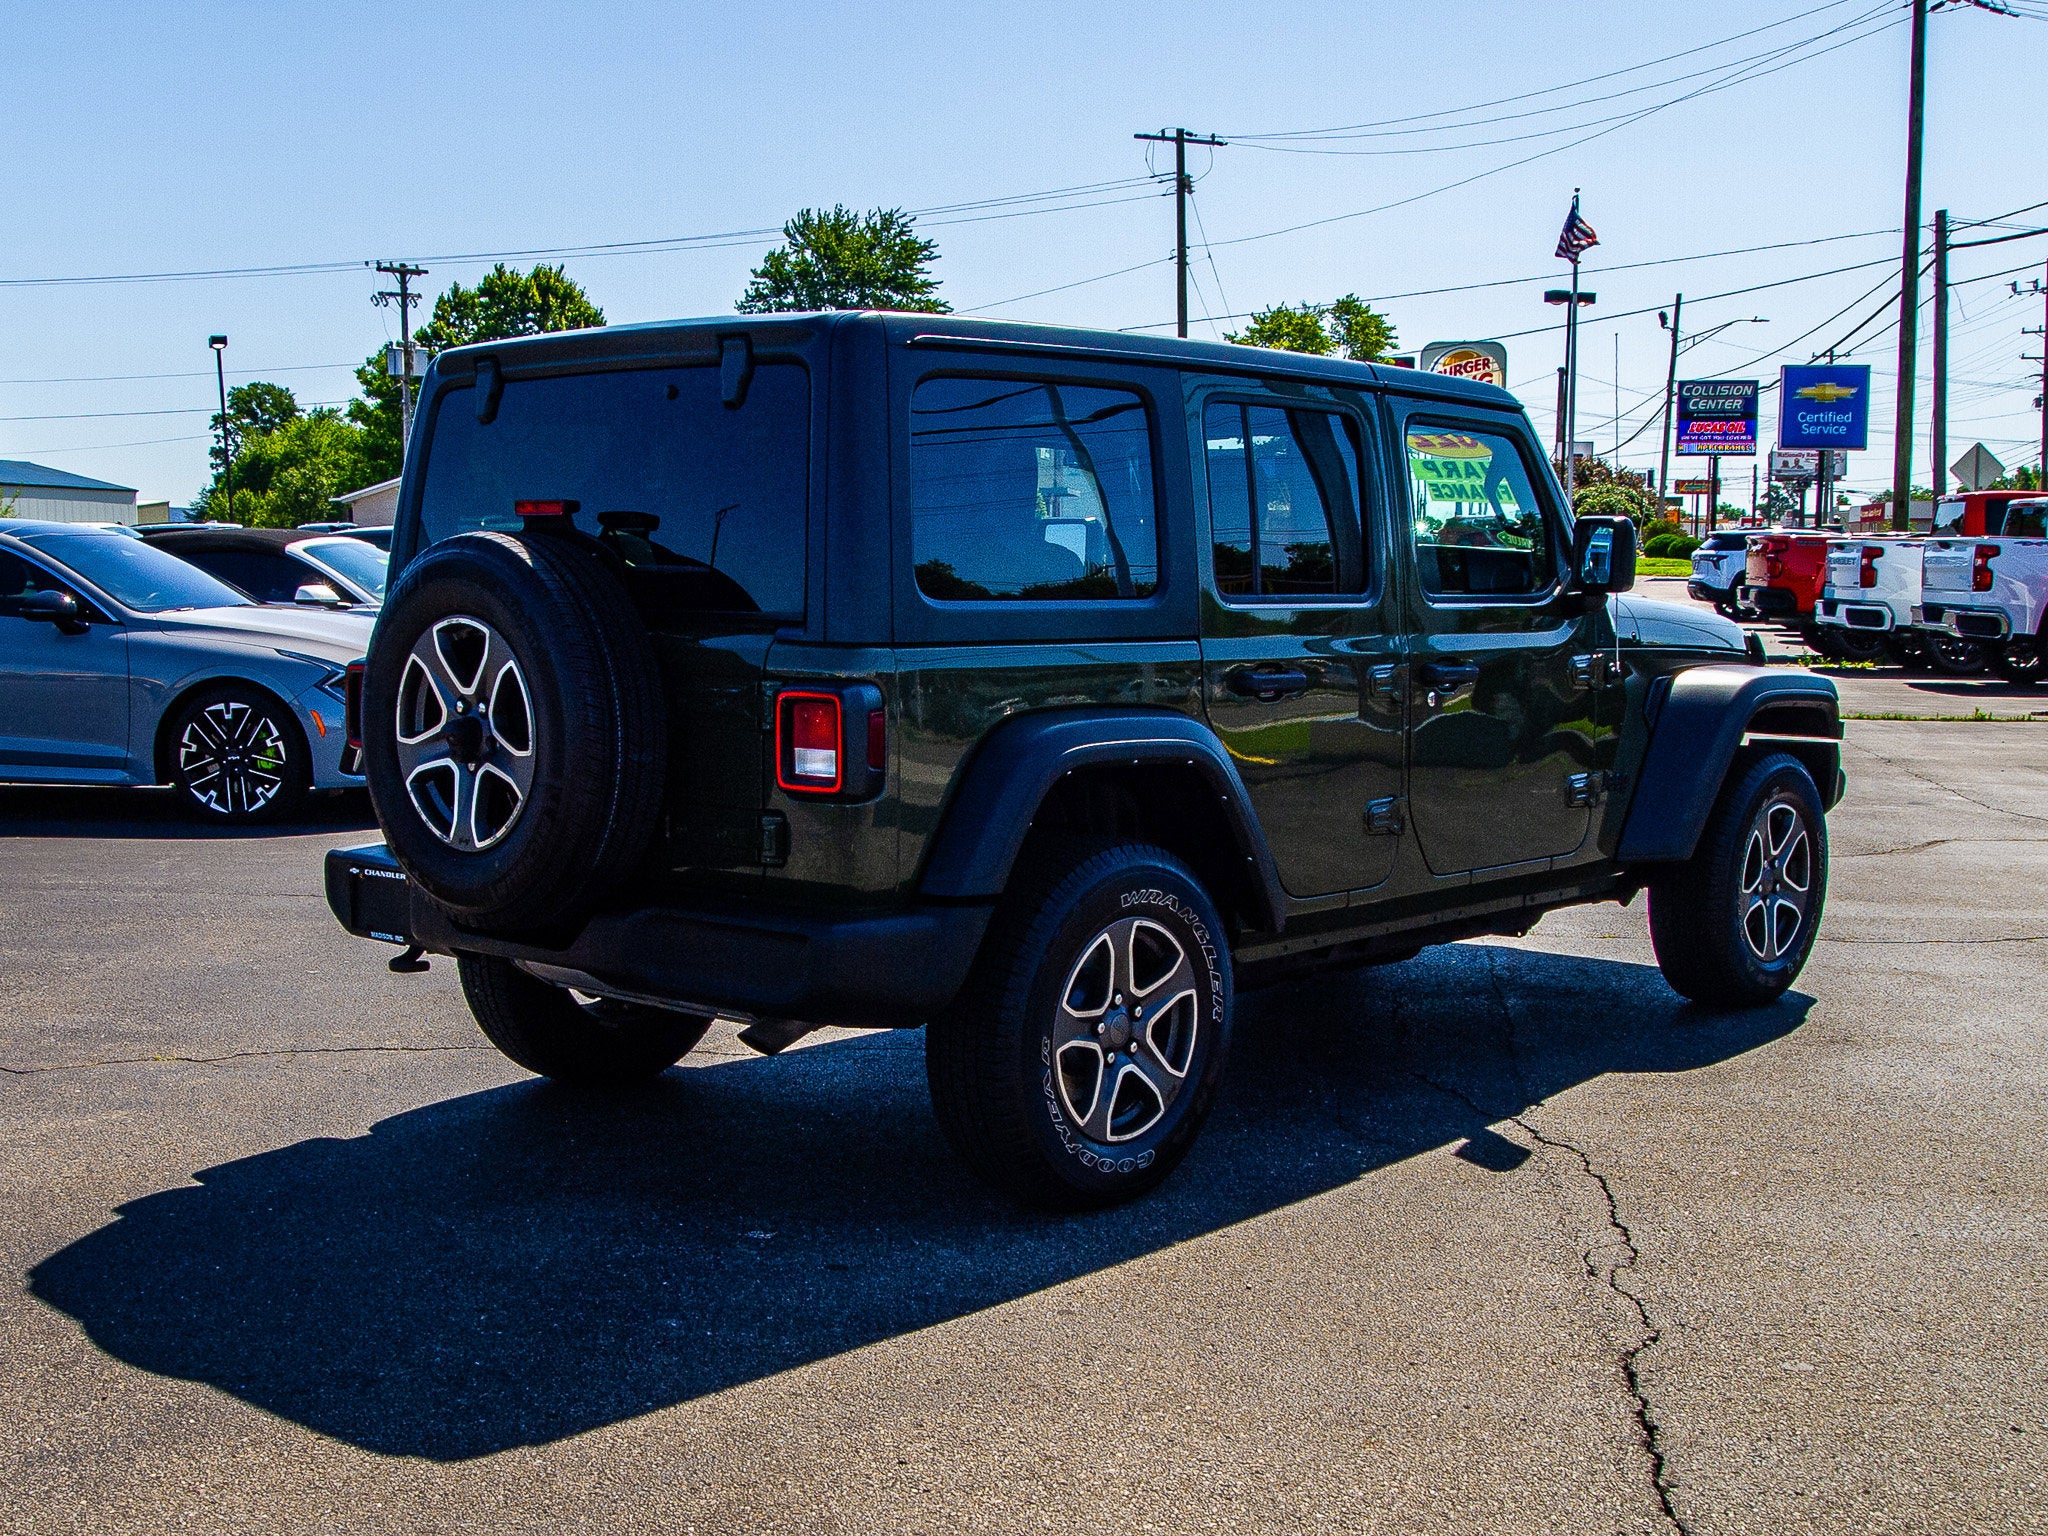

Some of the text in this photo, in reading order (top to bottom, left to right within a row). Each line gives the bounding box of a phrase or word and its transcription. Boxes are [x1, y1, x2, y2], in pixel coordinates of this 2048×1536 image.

[1682, 384, 1753, 396] COLLISION
[1689, 398, 1743, 409] CENTER
[1797, 411, 1852, 422] Certified
[1687, 421, 1746, 433] LUCAS OIL
[1801, 423, 1847, 434] Service
[364, 868, 406, 880] CHANDLER
[1120, 889, 1224, 1023] WRANGLER
[1041, 1036, 1156, 1173] GOODYEAR
